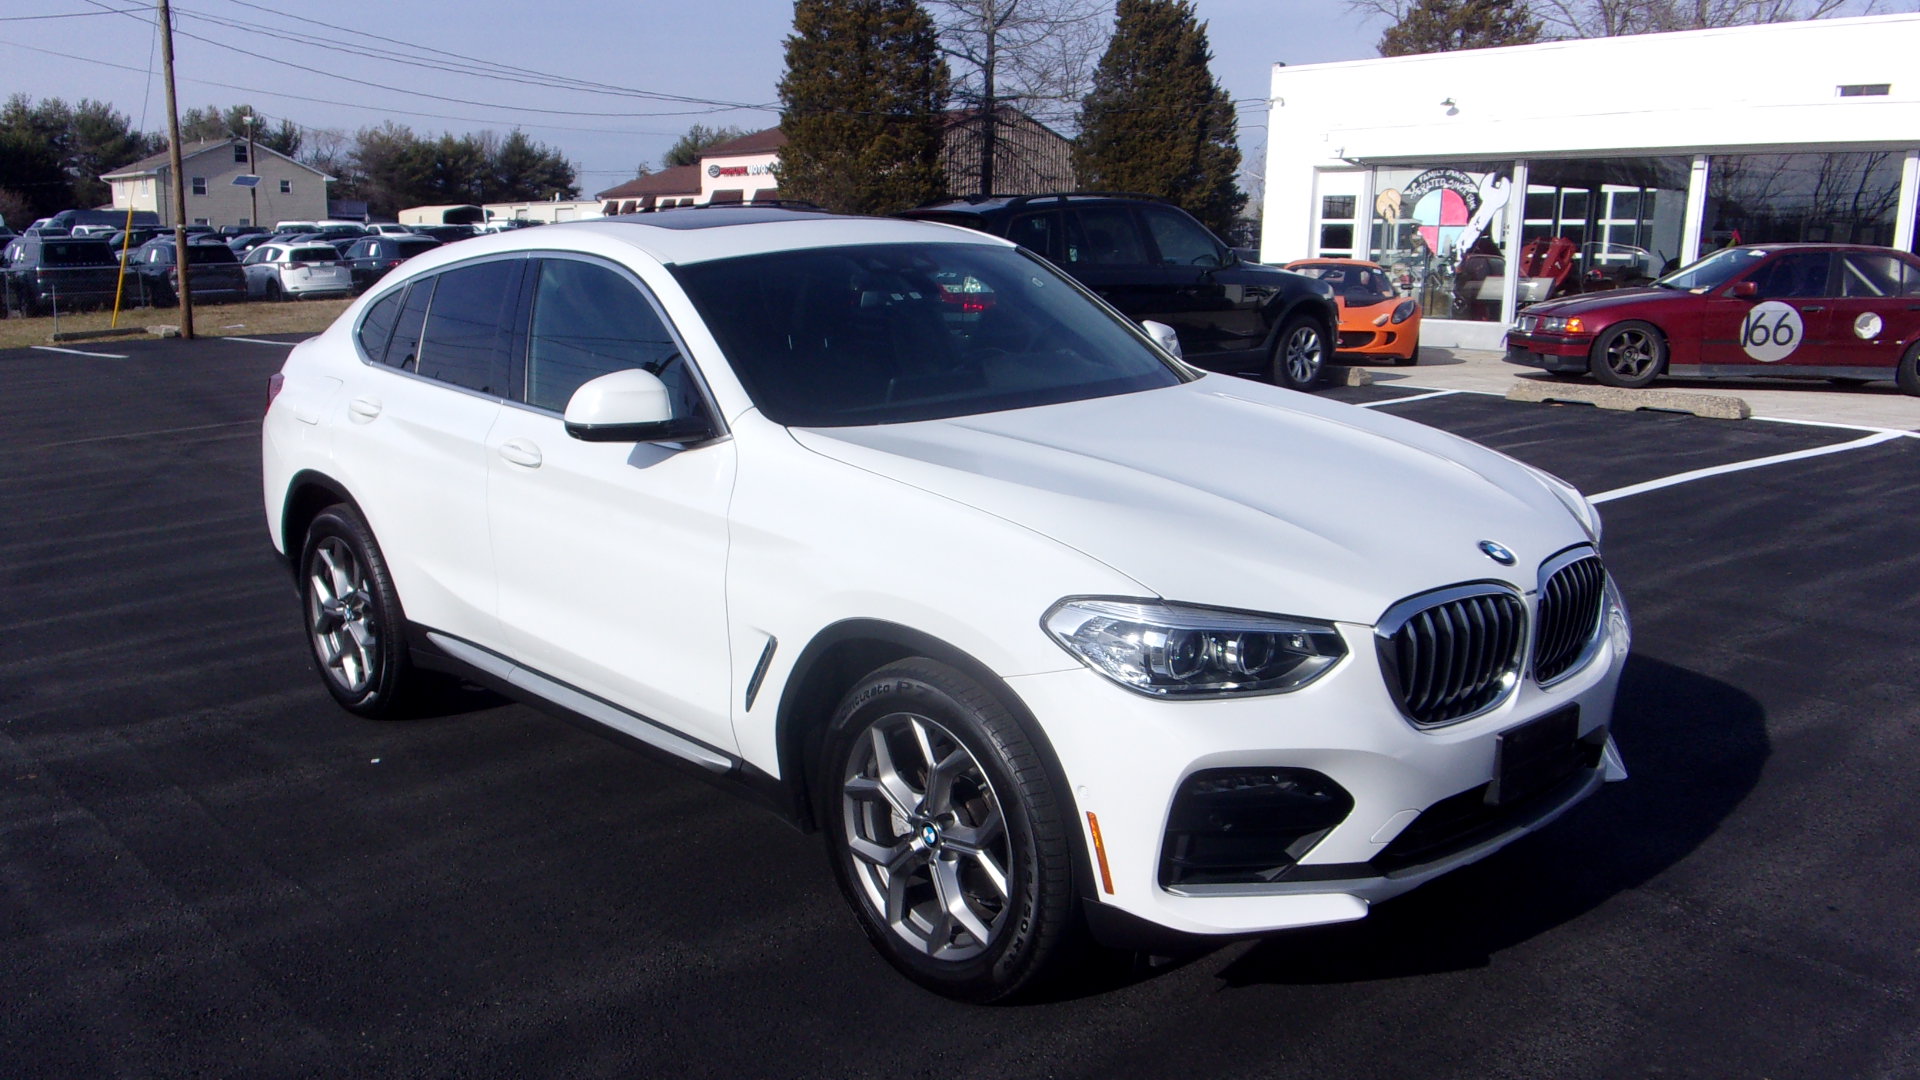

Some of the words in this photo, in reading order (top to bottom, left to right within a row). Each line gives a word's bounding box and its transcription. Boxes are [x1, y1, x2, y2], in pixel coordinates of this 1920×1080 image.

[1419, 170, 1444, 183] FAMILY
[1446, 170, 1470, 184] OWNED
[1743, 312, 1794, 348] 166
